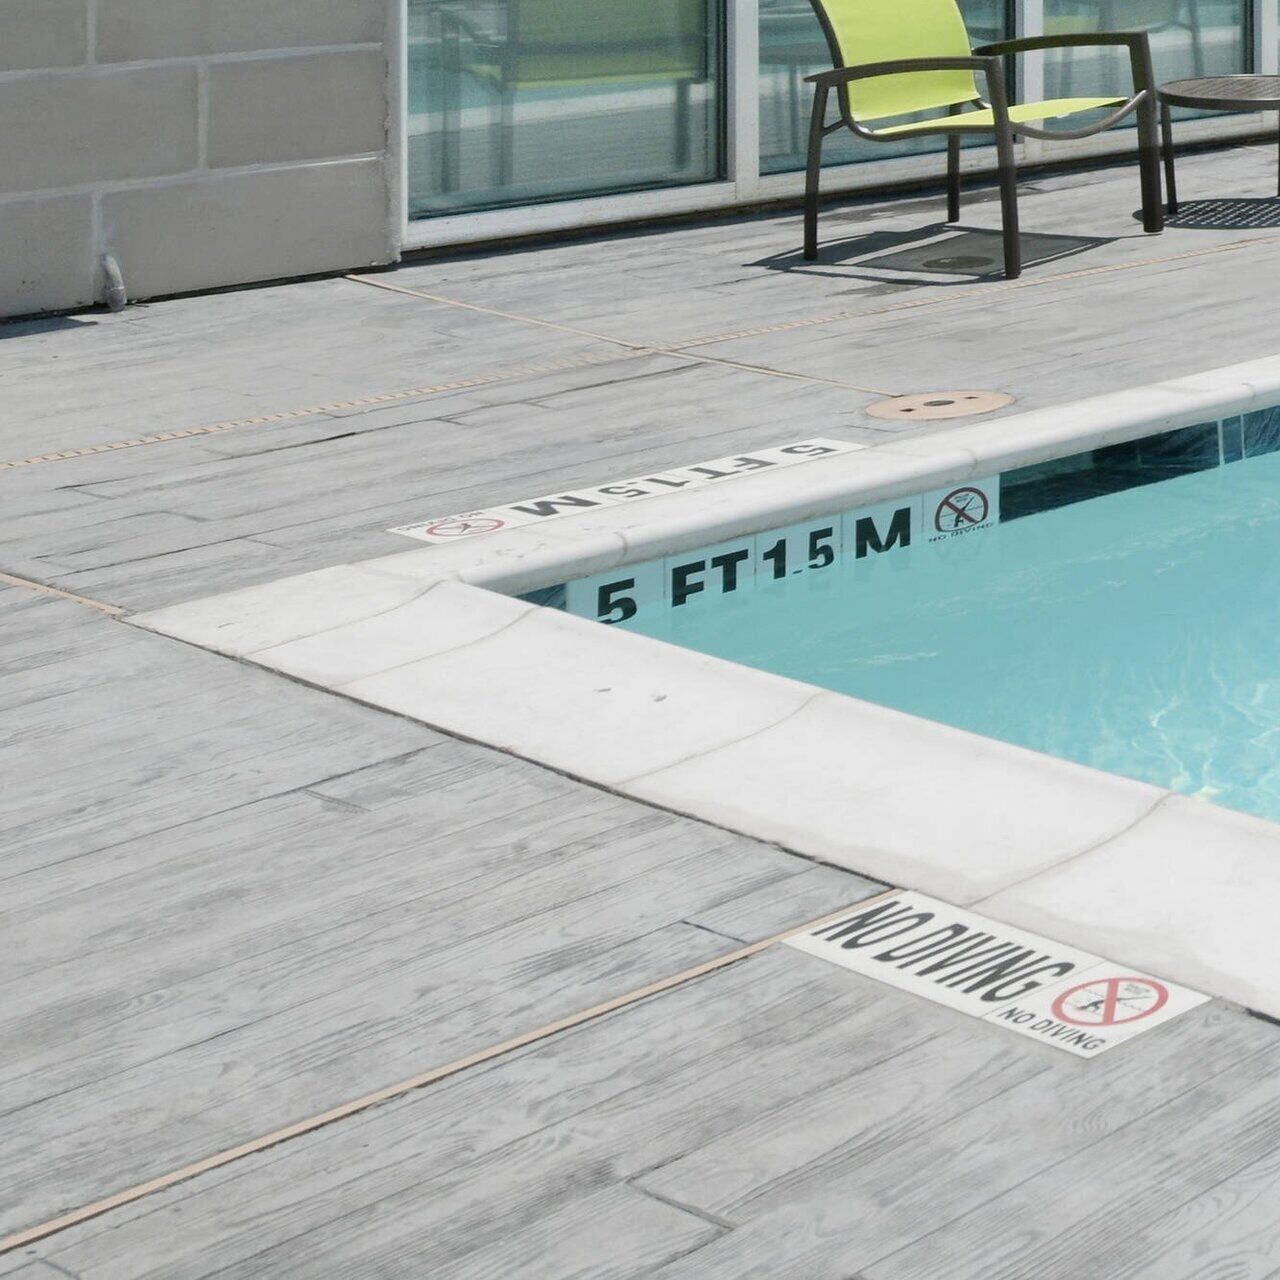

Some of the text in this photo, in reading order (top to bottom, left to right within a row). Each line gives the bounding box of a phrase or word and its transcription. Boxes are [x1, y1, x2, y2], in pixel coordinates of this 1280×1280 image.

[780, 444, 839, 457] 5
[687, 456, 778, 480] FT
[508, 495, 603, 517] M
[597, 578, 638, 624] 5
[671, 548, 749, 608] FT
[855, 506, 911, 559] M
[810, 900, 1077, 1003] NO DIVING
[997, 1006, 1106, 1051] NO DIVING
